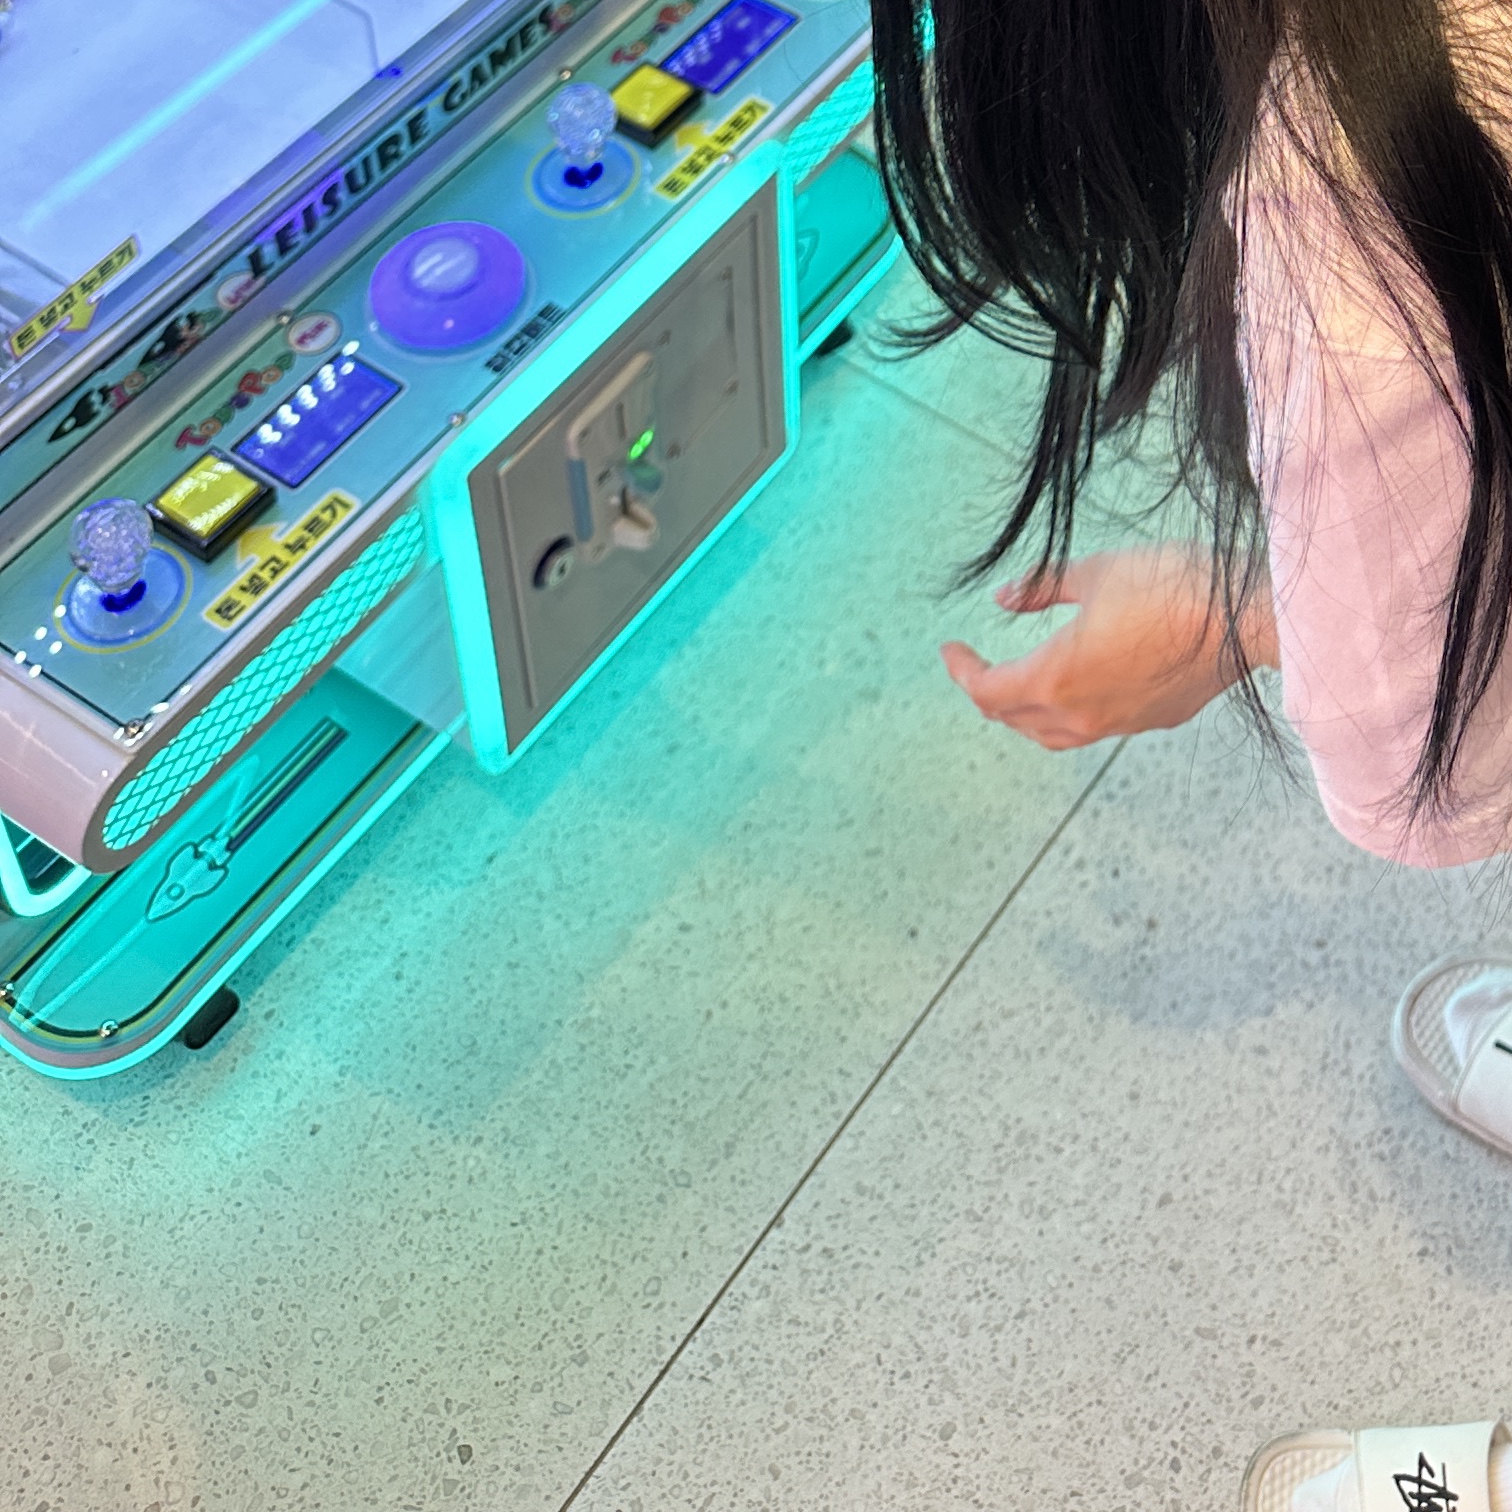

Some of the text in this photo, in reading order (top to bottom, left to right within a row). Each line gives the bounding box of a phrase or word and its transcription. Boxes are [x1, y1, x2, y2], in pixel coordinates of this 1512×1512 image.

[249, 104, 432, 279] LEISURE
[441, 3, 558, 115] GAMES
[283, 494, 352, 557] 누르기
